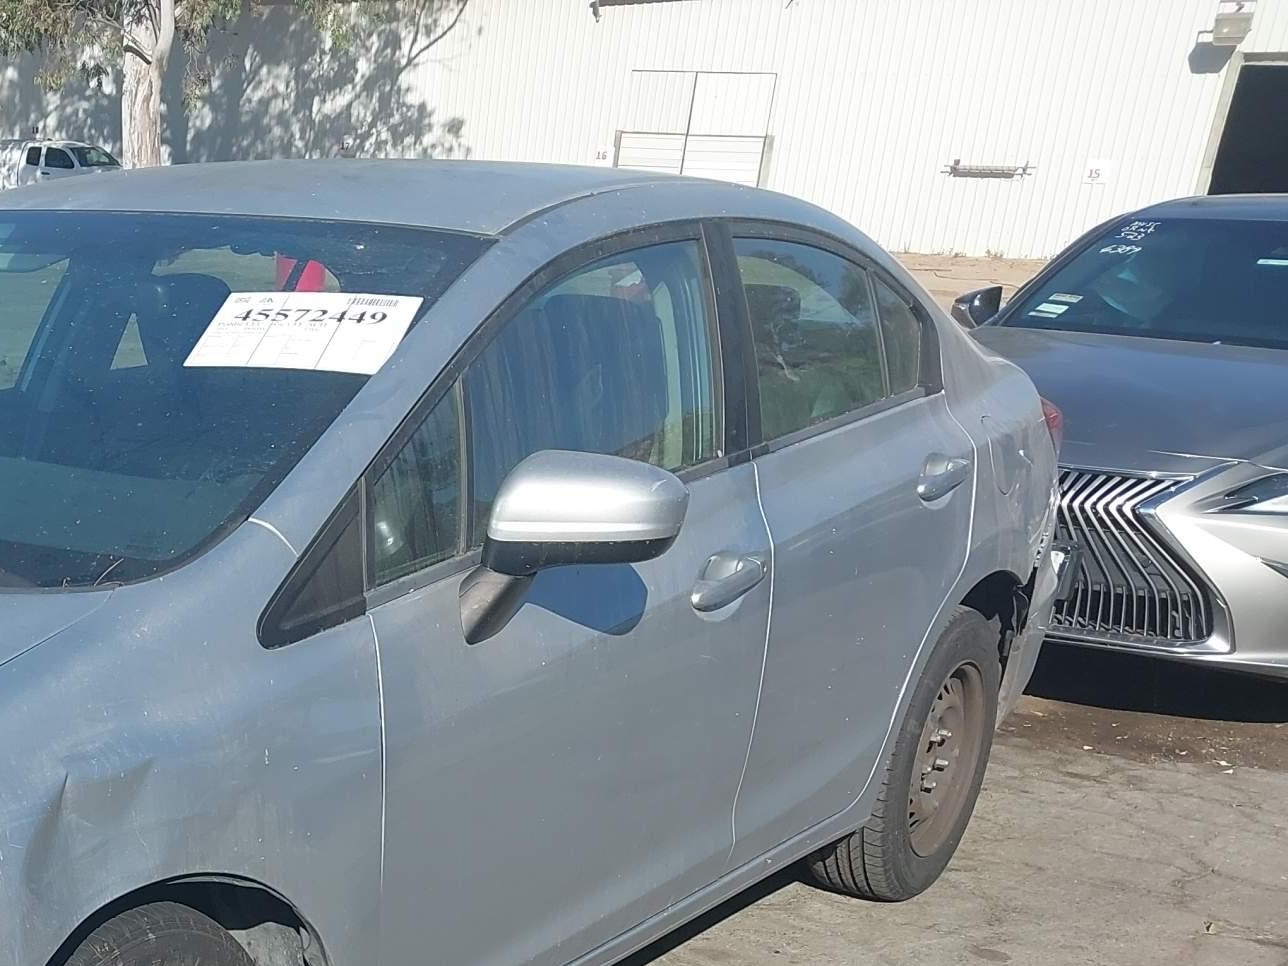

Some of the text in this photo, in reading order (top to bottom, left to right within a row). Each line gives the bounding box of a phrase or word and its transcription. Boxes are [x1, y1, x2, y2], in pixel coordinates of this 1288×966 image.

[596, 151, 608, 160] 16
[1088, 168, 1101, 178] 15
[234, 308, 388, 325] 45572449
